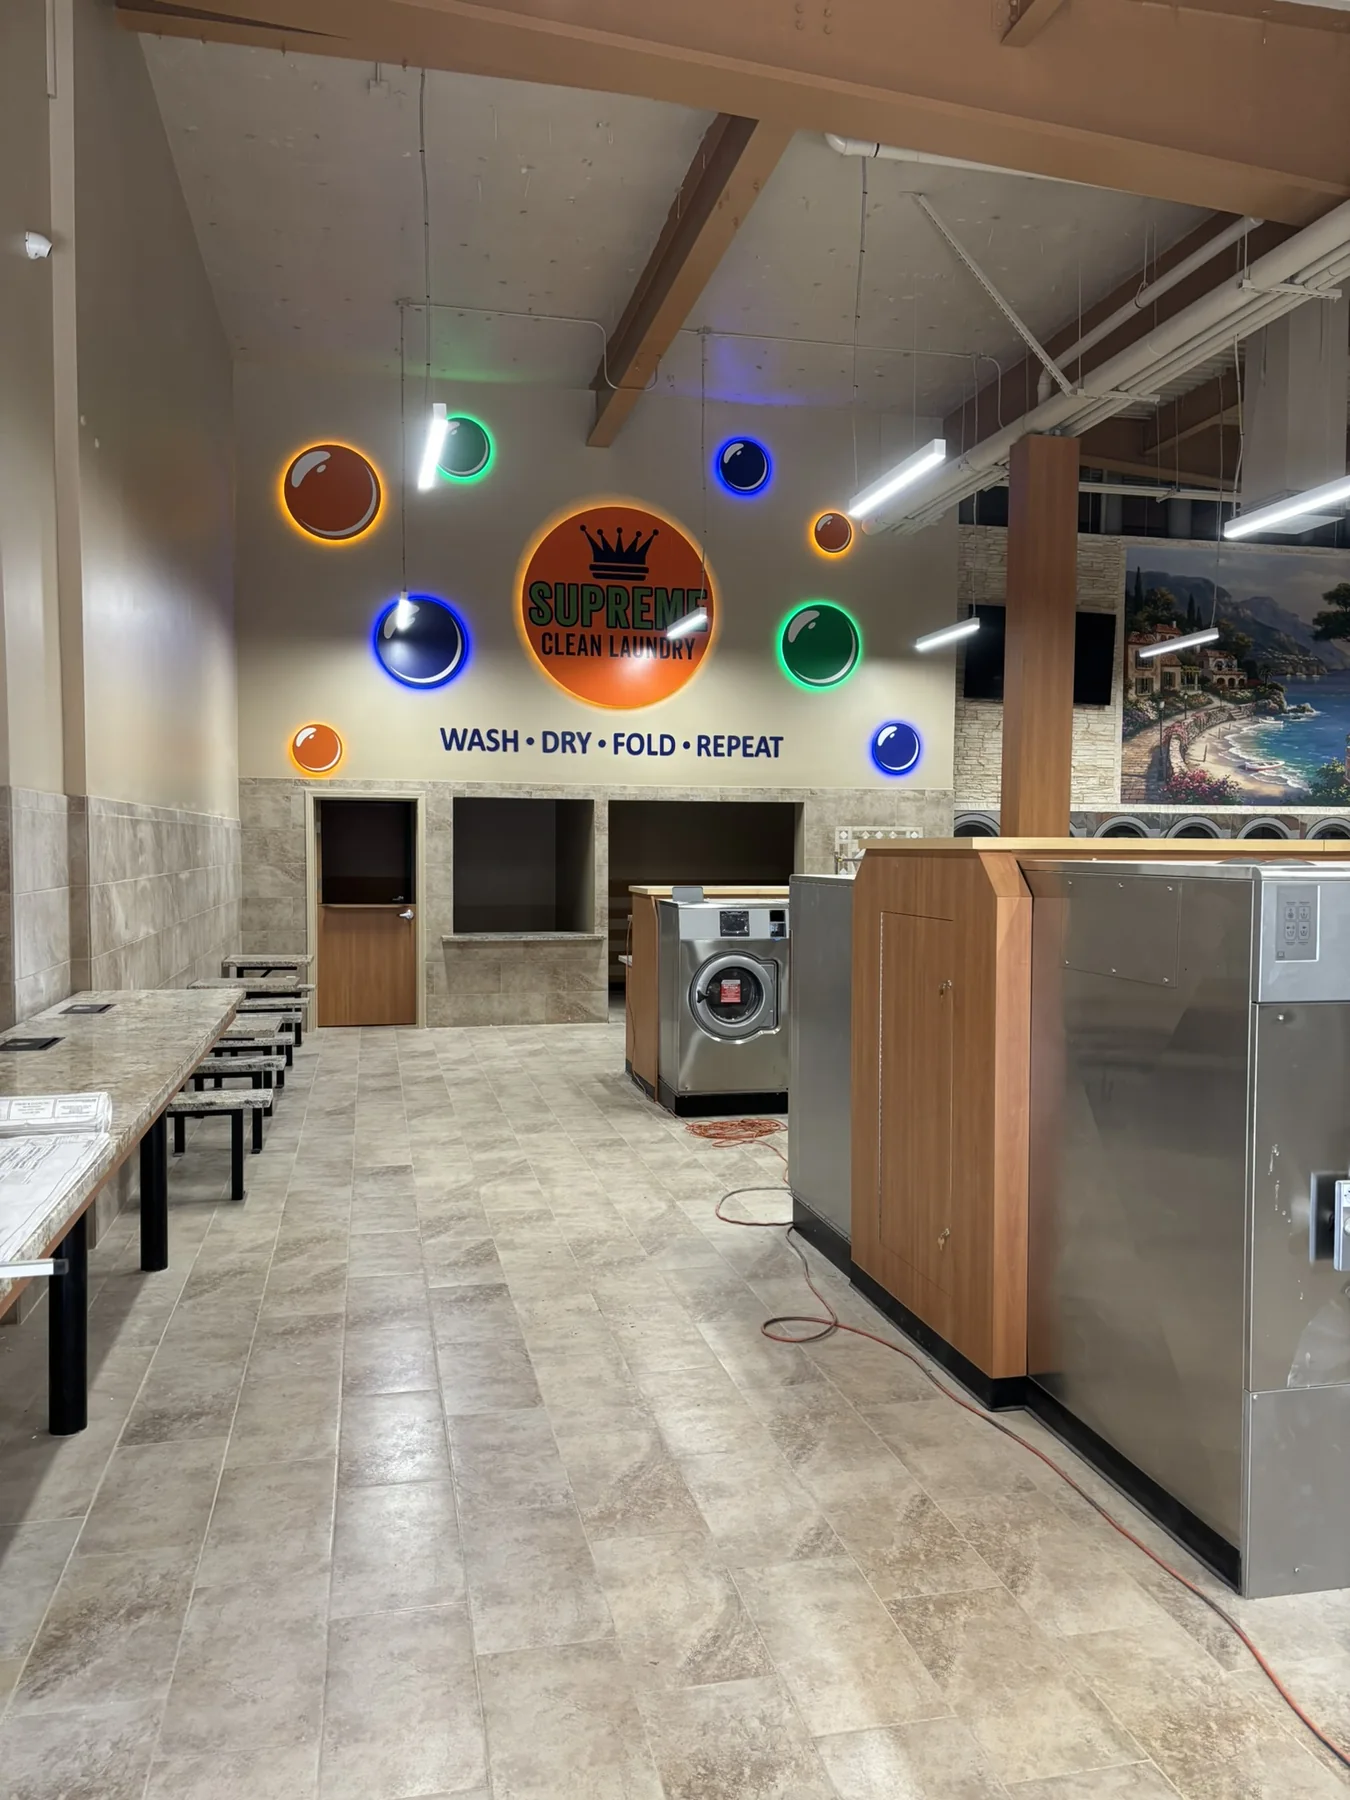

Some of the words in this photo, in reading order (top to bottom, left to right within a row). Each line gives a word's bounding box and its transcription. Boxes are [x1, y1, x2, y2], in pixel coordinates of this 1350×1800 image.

[541, 632, 601, 657] CLEAN
[609, 635, 696, 660] LAUNDRY
[440, 728, 519, 752] WASH
[542, 731, 592, 754] DRY
[613, 733, 676, 756] FOLD
[697, 735, 784, 758] REPEAT
